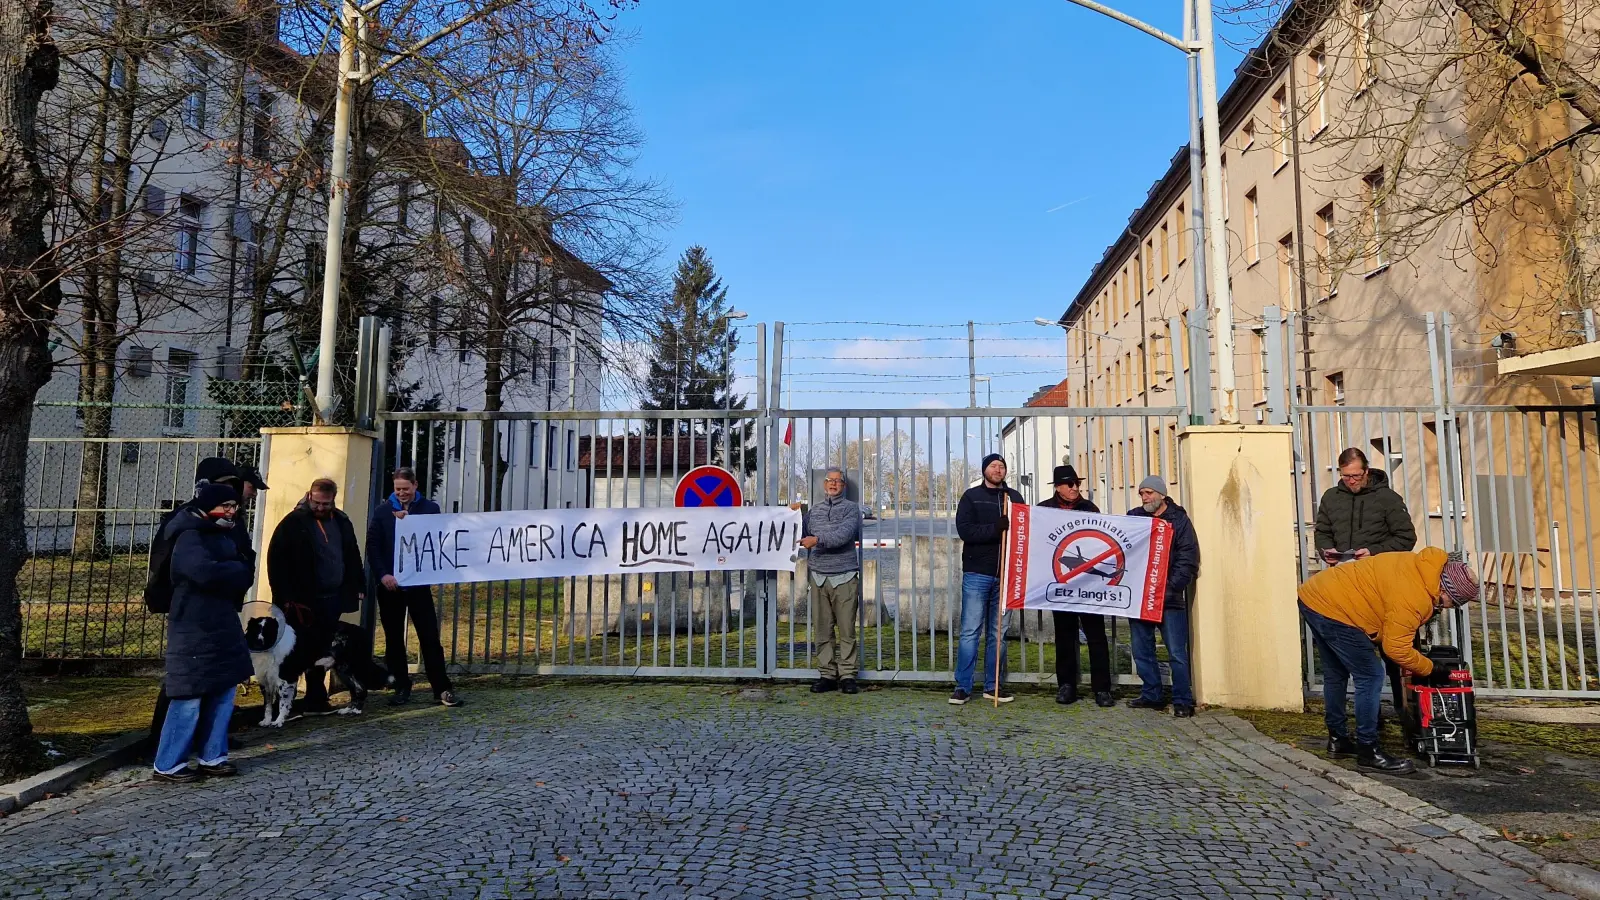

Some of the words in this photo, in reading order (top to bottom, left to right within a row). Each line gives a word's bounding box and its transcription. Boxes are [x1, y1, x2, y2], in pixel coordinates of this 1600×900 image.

[399, 530, 469, 573] MAKE
[487, 522, 608, 563] AMERICA
[622, 521, 688, 562] HOME
[702, 521, 798, 562] AGAIN!
[1048, 517, 1133, 549] Bürgerinitiative
[1014, 511, 1026, 600] www.etz-langts.de
[1055, 588, 1074, 597] Etz
